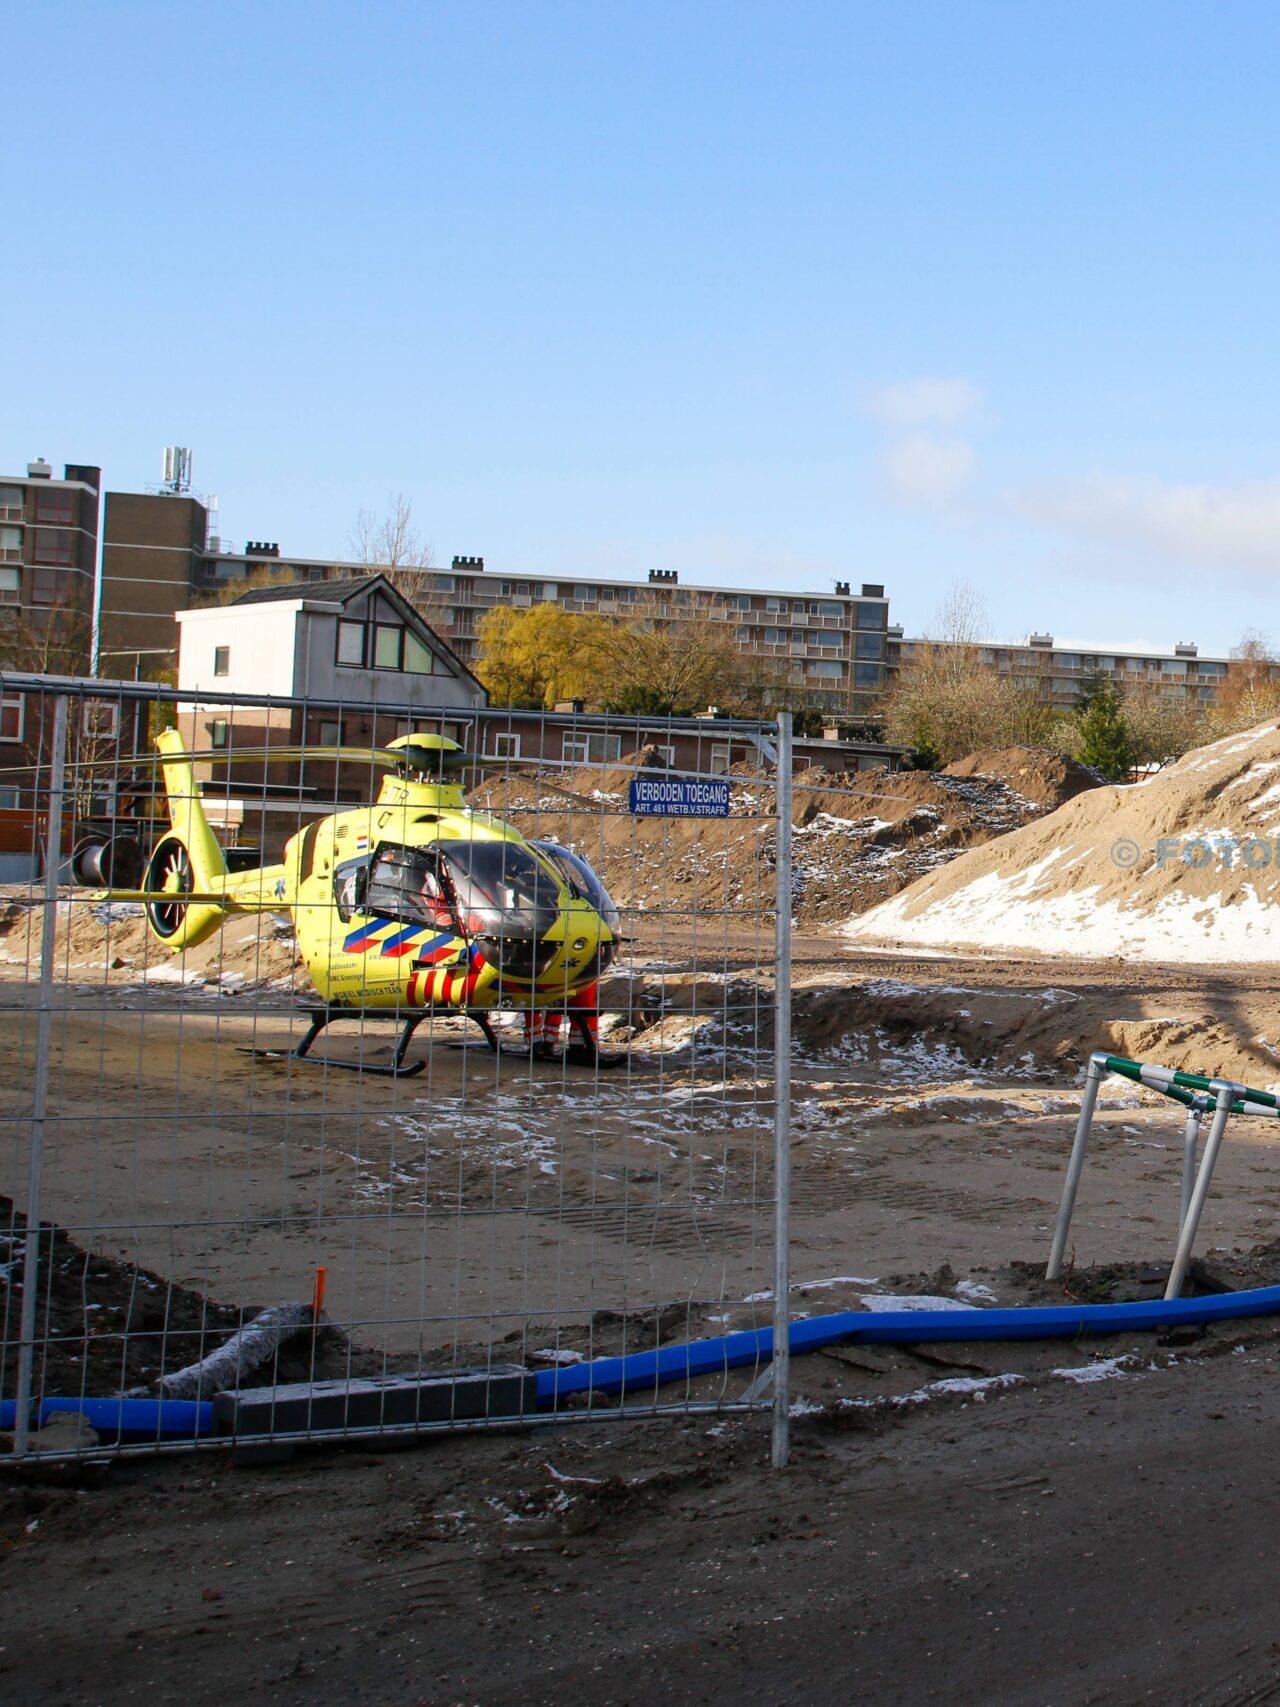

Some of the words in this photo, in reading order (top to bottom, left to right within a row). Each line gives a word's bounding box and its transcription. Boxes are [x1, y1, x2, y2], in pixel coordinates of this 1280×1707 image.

[635, 782, 684, 802] VERBODEN
[686, 784, 728, 803] TOEGANG
[635, 803, 652, 813] ART.
[653, 804, 666, 814] 461
[333, 990, 357, 999] MOBIEL
